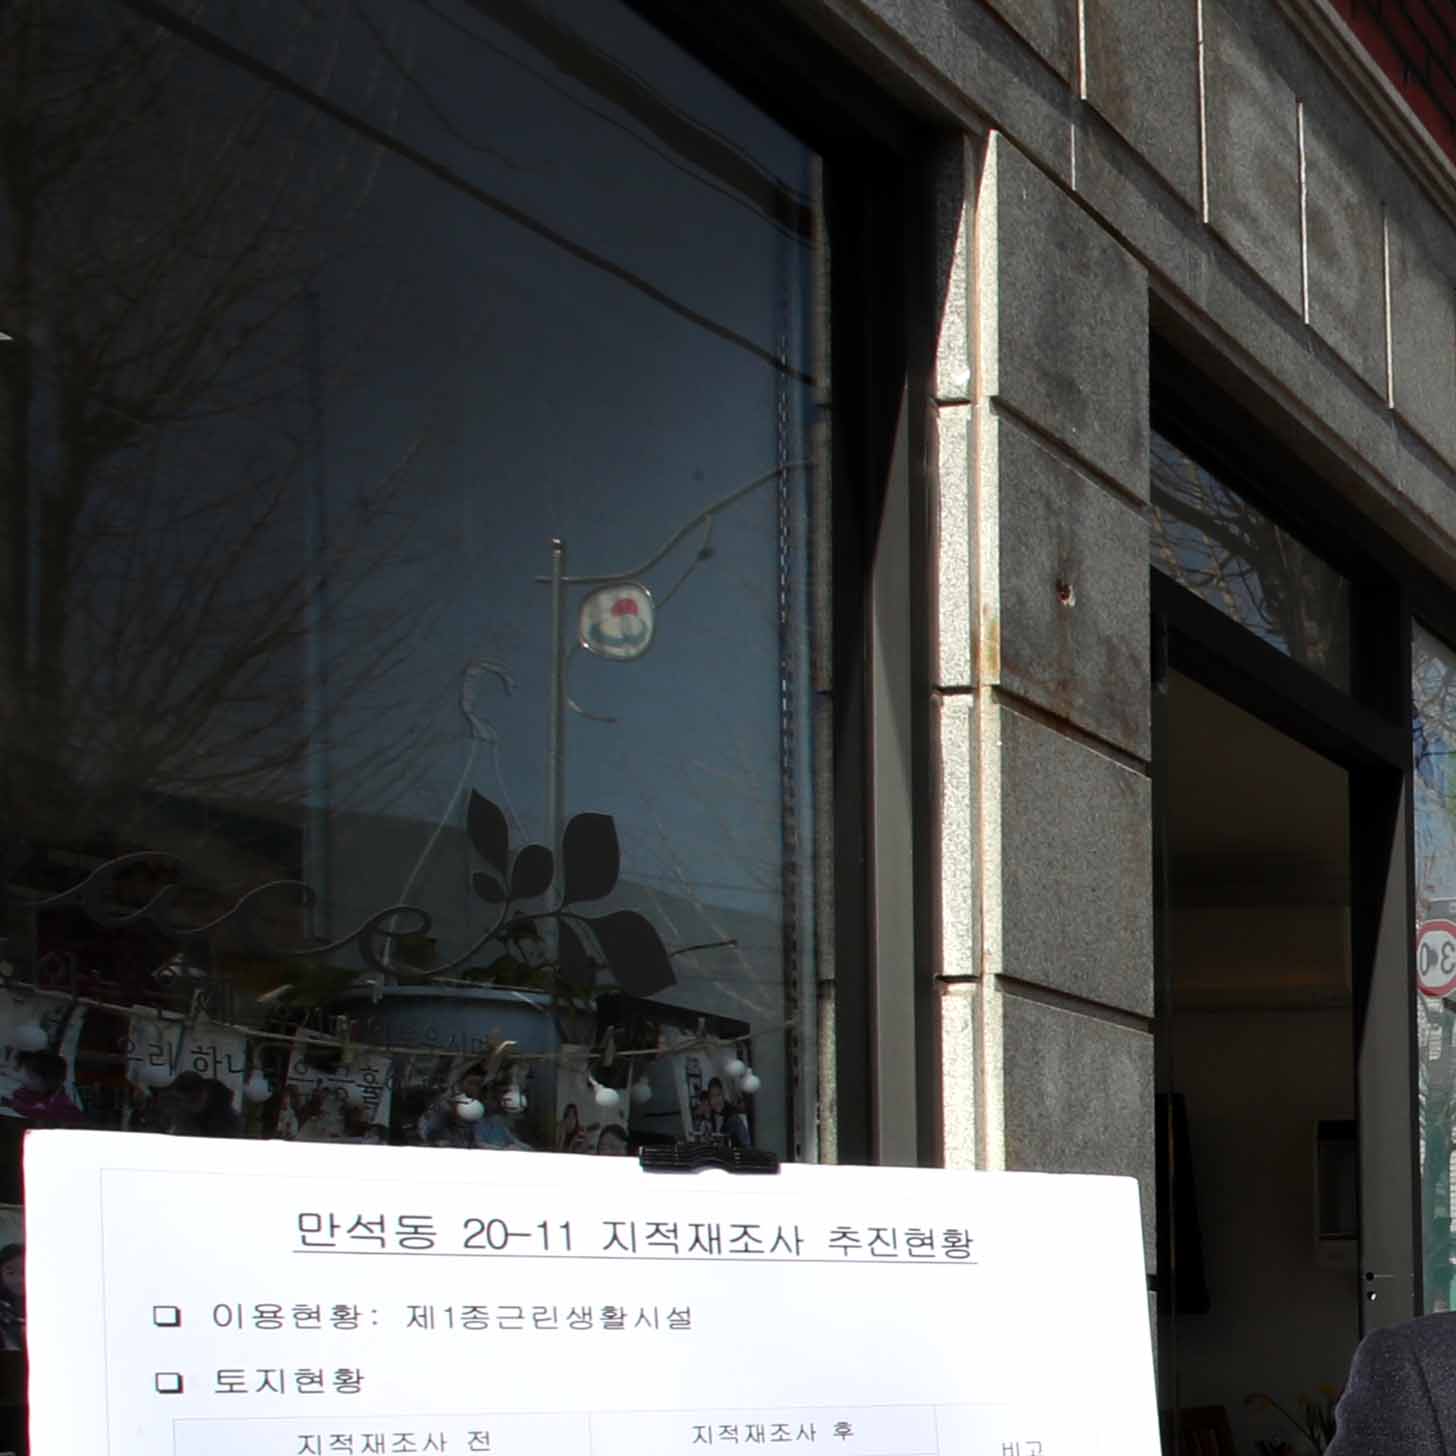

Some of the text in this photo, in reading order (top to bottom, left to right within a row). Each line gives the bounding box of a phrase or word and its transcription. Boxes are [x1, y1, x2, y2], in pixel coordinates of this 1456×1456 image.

[298, 1213, 973, 1259] 만석동 20-11 지적재조사 추진현황
[213, 1304, 691, 1330] 이용현황: 제1종근린생활시설
[215, 1368, 364, 1394] 토지현황
[298, 1431, 490, 1456] 지적재조사 전
[693, 1422, 853, 1444] 지적재조사 후
